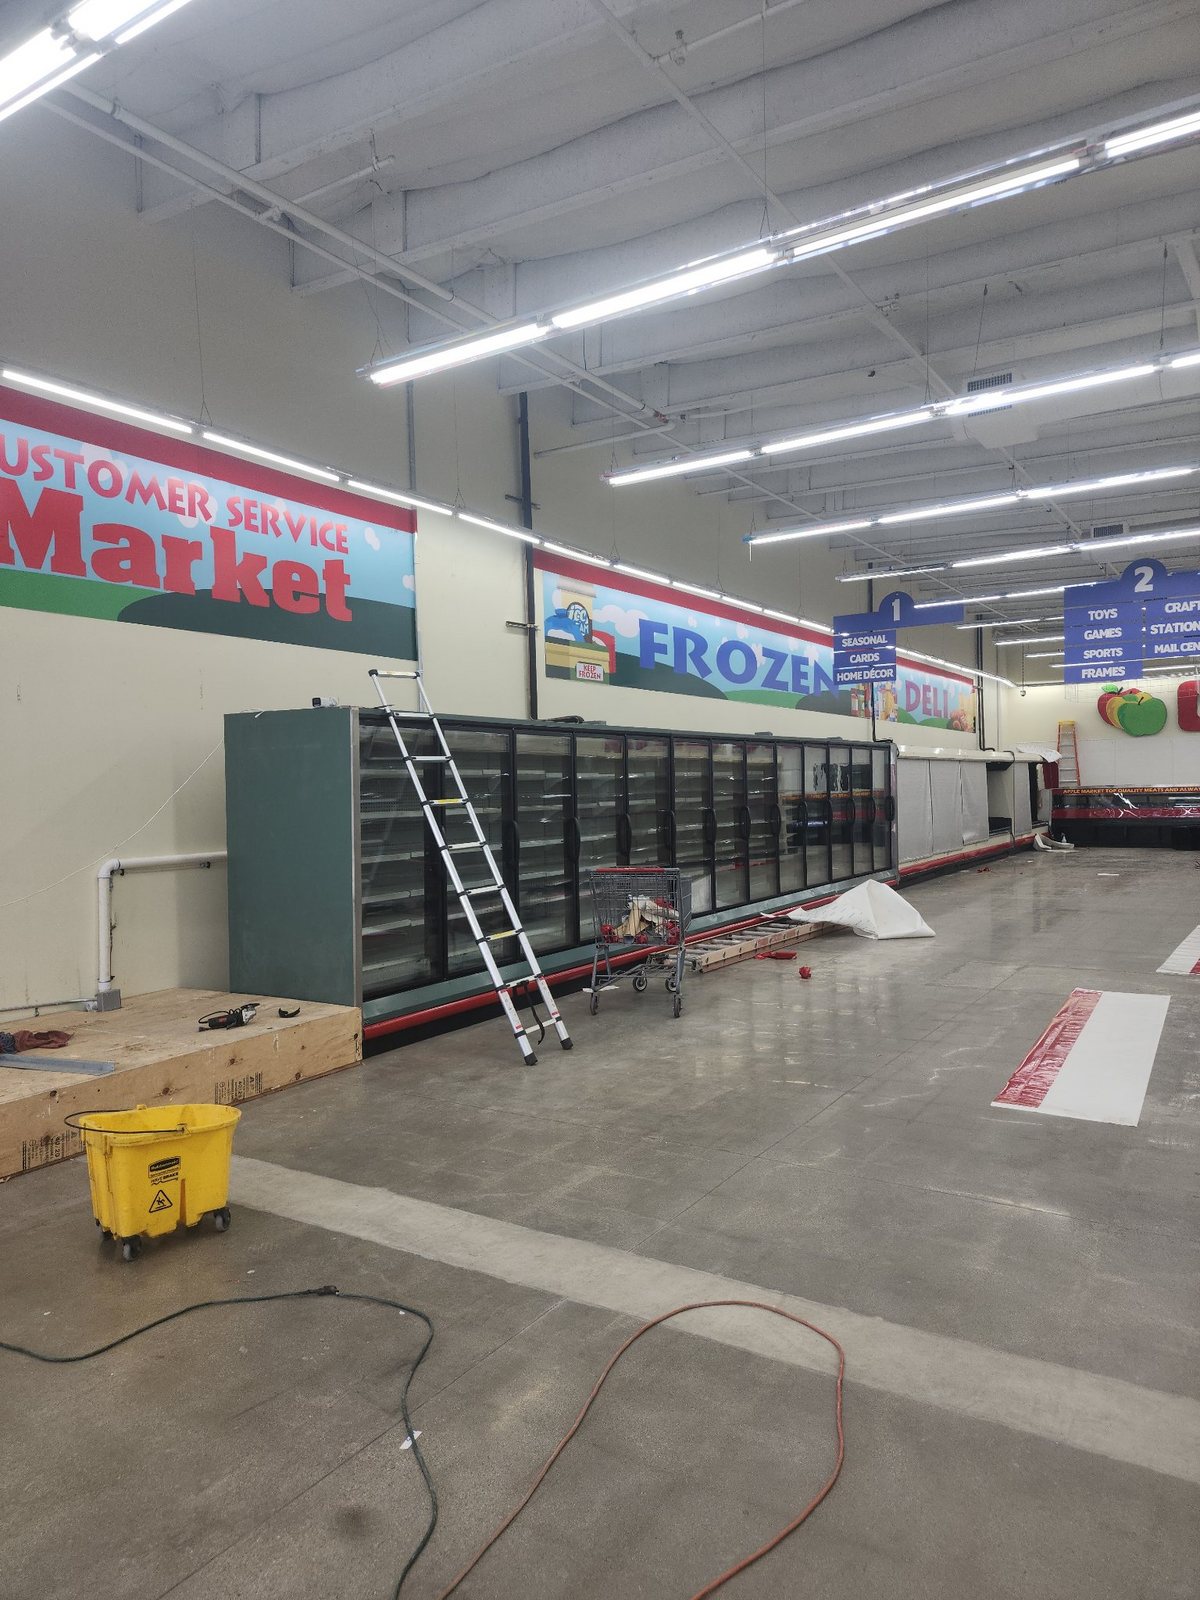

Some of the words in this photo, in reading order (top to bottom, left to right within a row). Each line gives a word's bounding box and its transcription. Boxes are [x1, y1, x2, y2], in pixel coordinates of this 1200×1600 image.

[227, 496, 349, 554] SERVICE
[0, 476, 353, 622] Market
[1134, 566, 1154, 592] 2
[892, 598, 901, 621] 1
[1088, 608, 1118, 620] TOYS
[1084, 627, 1122, 640] GAMES
[842, 635, 888, 648] SEASONAL
[1154, 643, 1179, 653] MAIL
[639, 618, 840, 699] FROZEN
[849, 652, 880, 663] CARDS
[1083, 647, 1123, 659] SPORTS
[578, 670, 602, 680] FROZEN
[837, 671, 863, 682] HOME
[863, 667, 894, 679] DÉCOR
[1081, 666, 1126, 679] FRAMES
[904, 680, 949, 719] DELI
